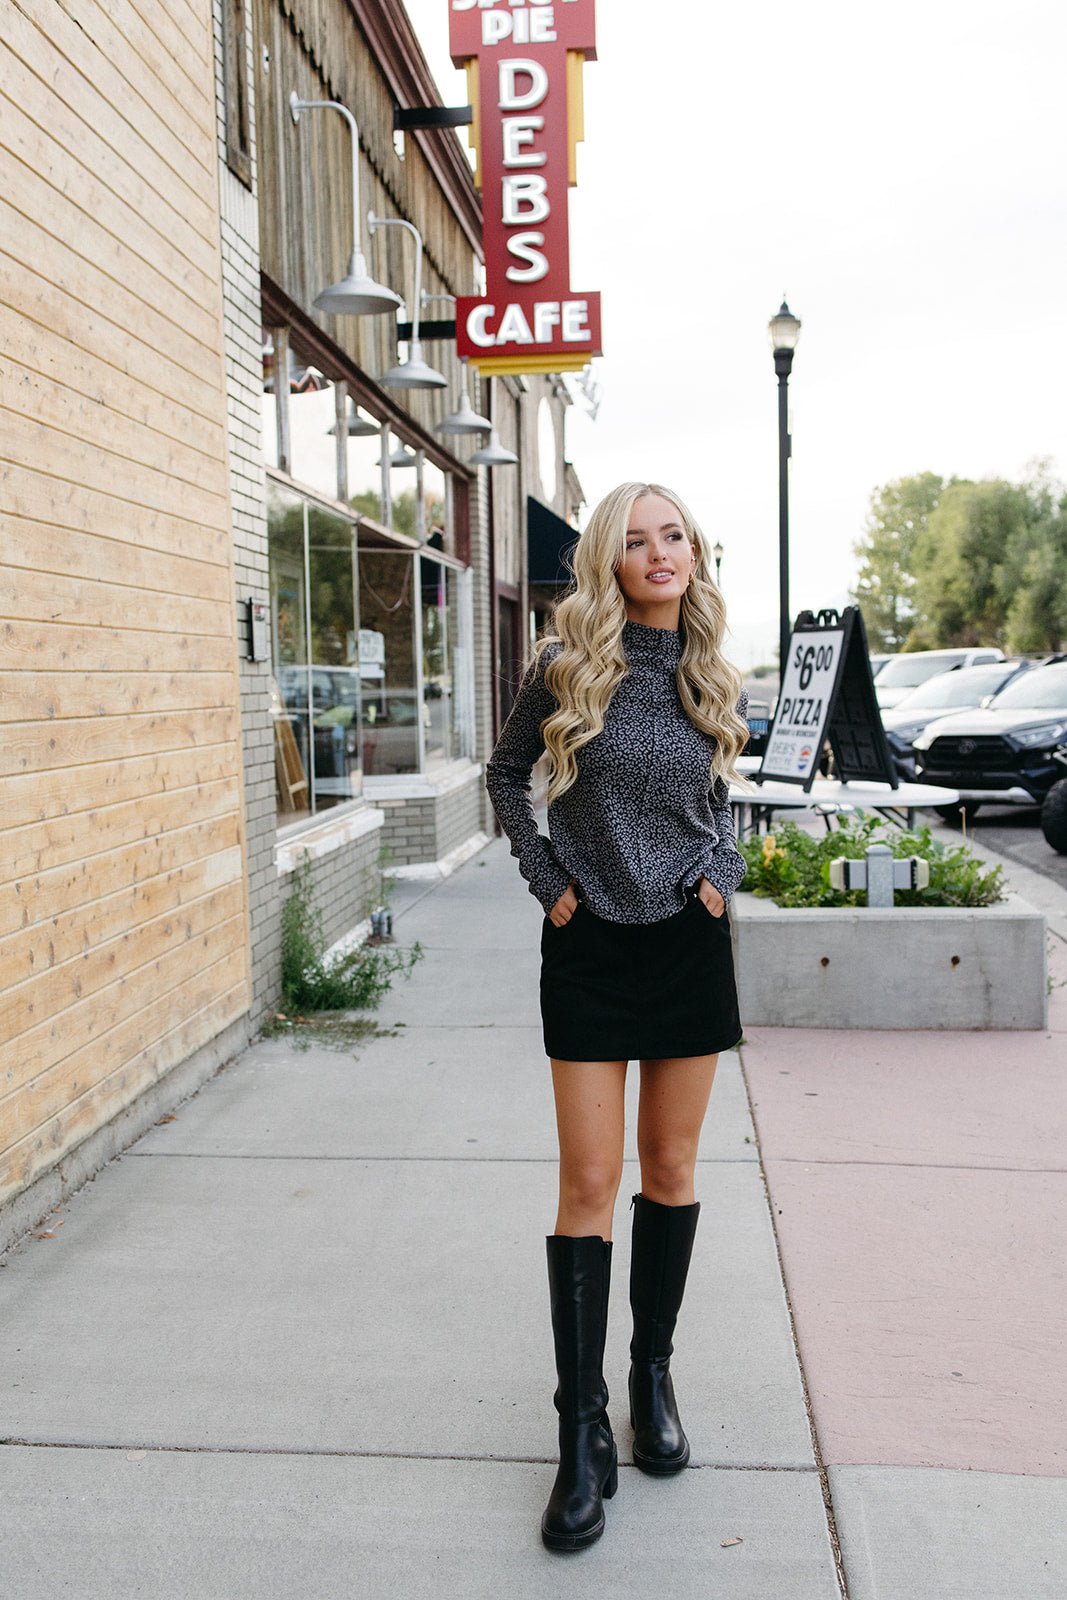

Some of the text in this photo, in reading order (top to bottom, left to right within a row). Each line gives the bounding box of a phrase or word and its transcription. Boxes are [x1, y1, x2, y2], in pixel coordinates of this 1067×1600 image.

[481, 6, 557, 46] PIE
[498, 58, 550, 283] DEBS
[466, 300, 591, 347] CAFE
[778, 698, 822, 726] PIZZA
